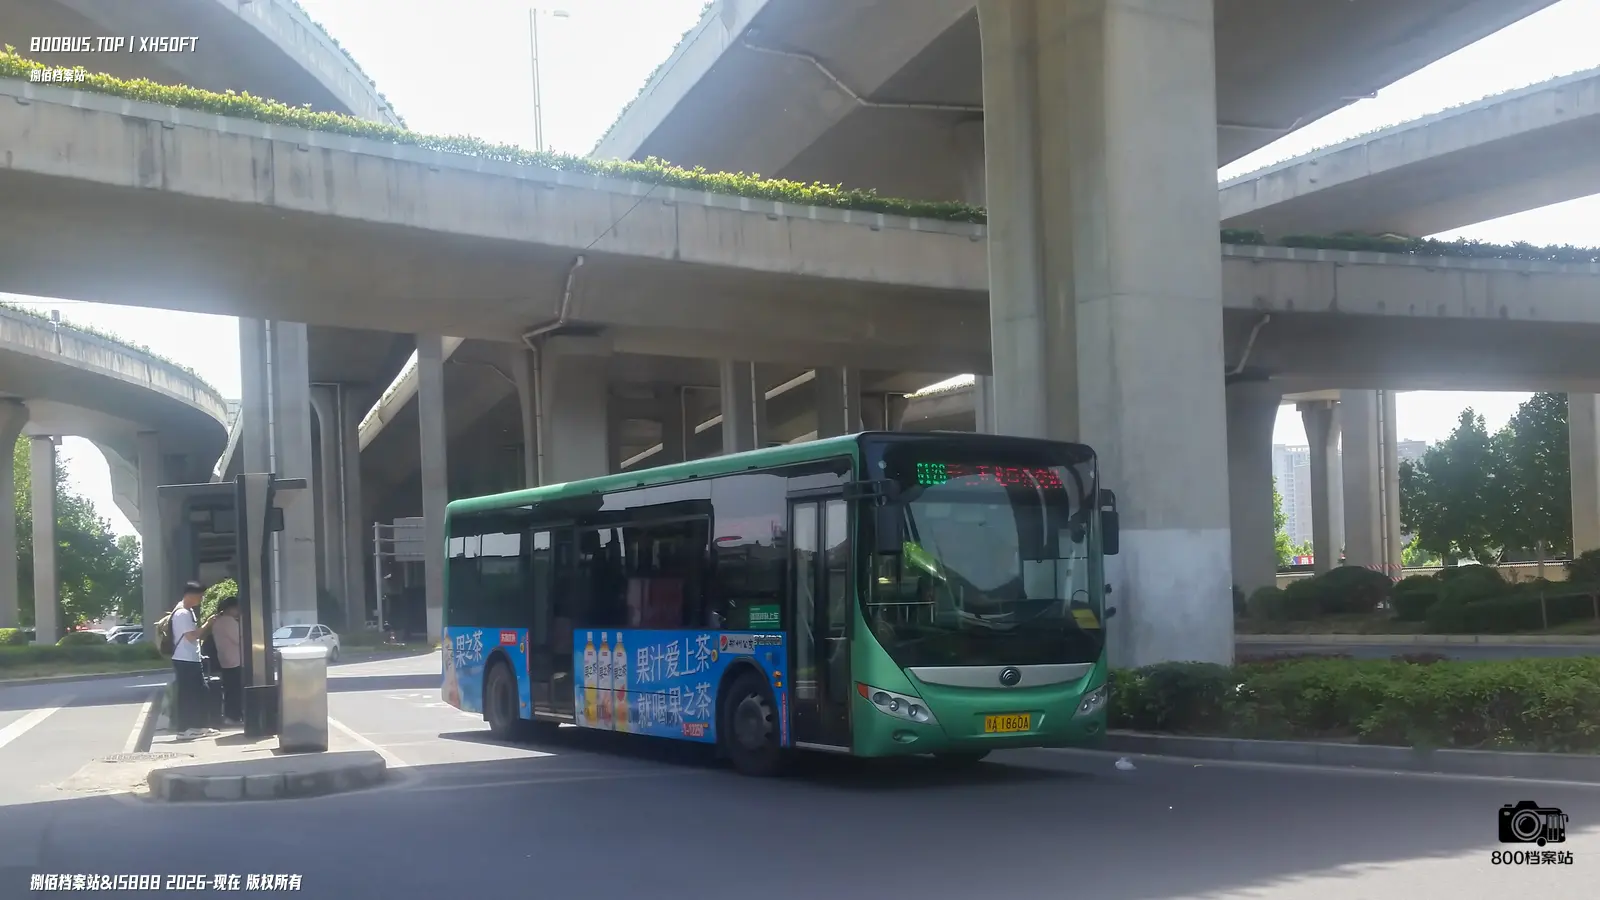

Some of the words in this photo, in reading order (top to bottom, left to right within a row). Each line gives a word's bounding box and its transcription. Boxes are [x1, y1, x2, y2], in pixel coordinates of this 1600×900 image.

[455, 629, 484, 668] 果之茶
[636, 633, 711, 684] 果汁爱上茶
[637, 681, 711, 728] 就喝果之茶
